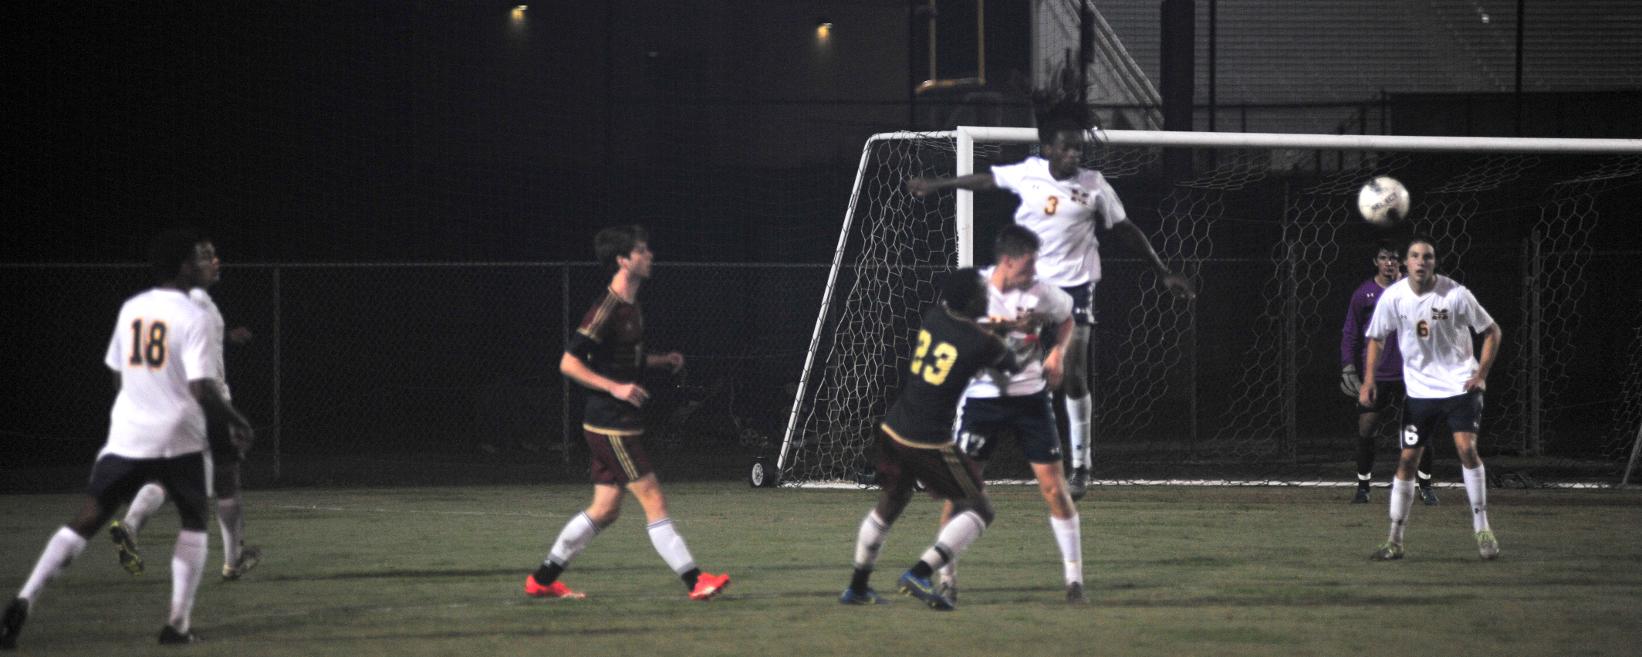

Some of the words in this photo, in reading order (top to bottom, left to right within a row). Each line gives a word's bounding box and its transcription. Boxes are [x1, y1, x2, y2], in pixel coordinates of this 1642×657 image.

[1044, 195, 1058, 216] 3
[1416, 319, 1430, 338] 6
[128, 317, 168, 369] 18
[911, 329, 958, 386] 23
[1404, 424, 1419, 446] 6
